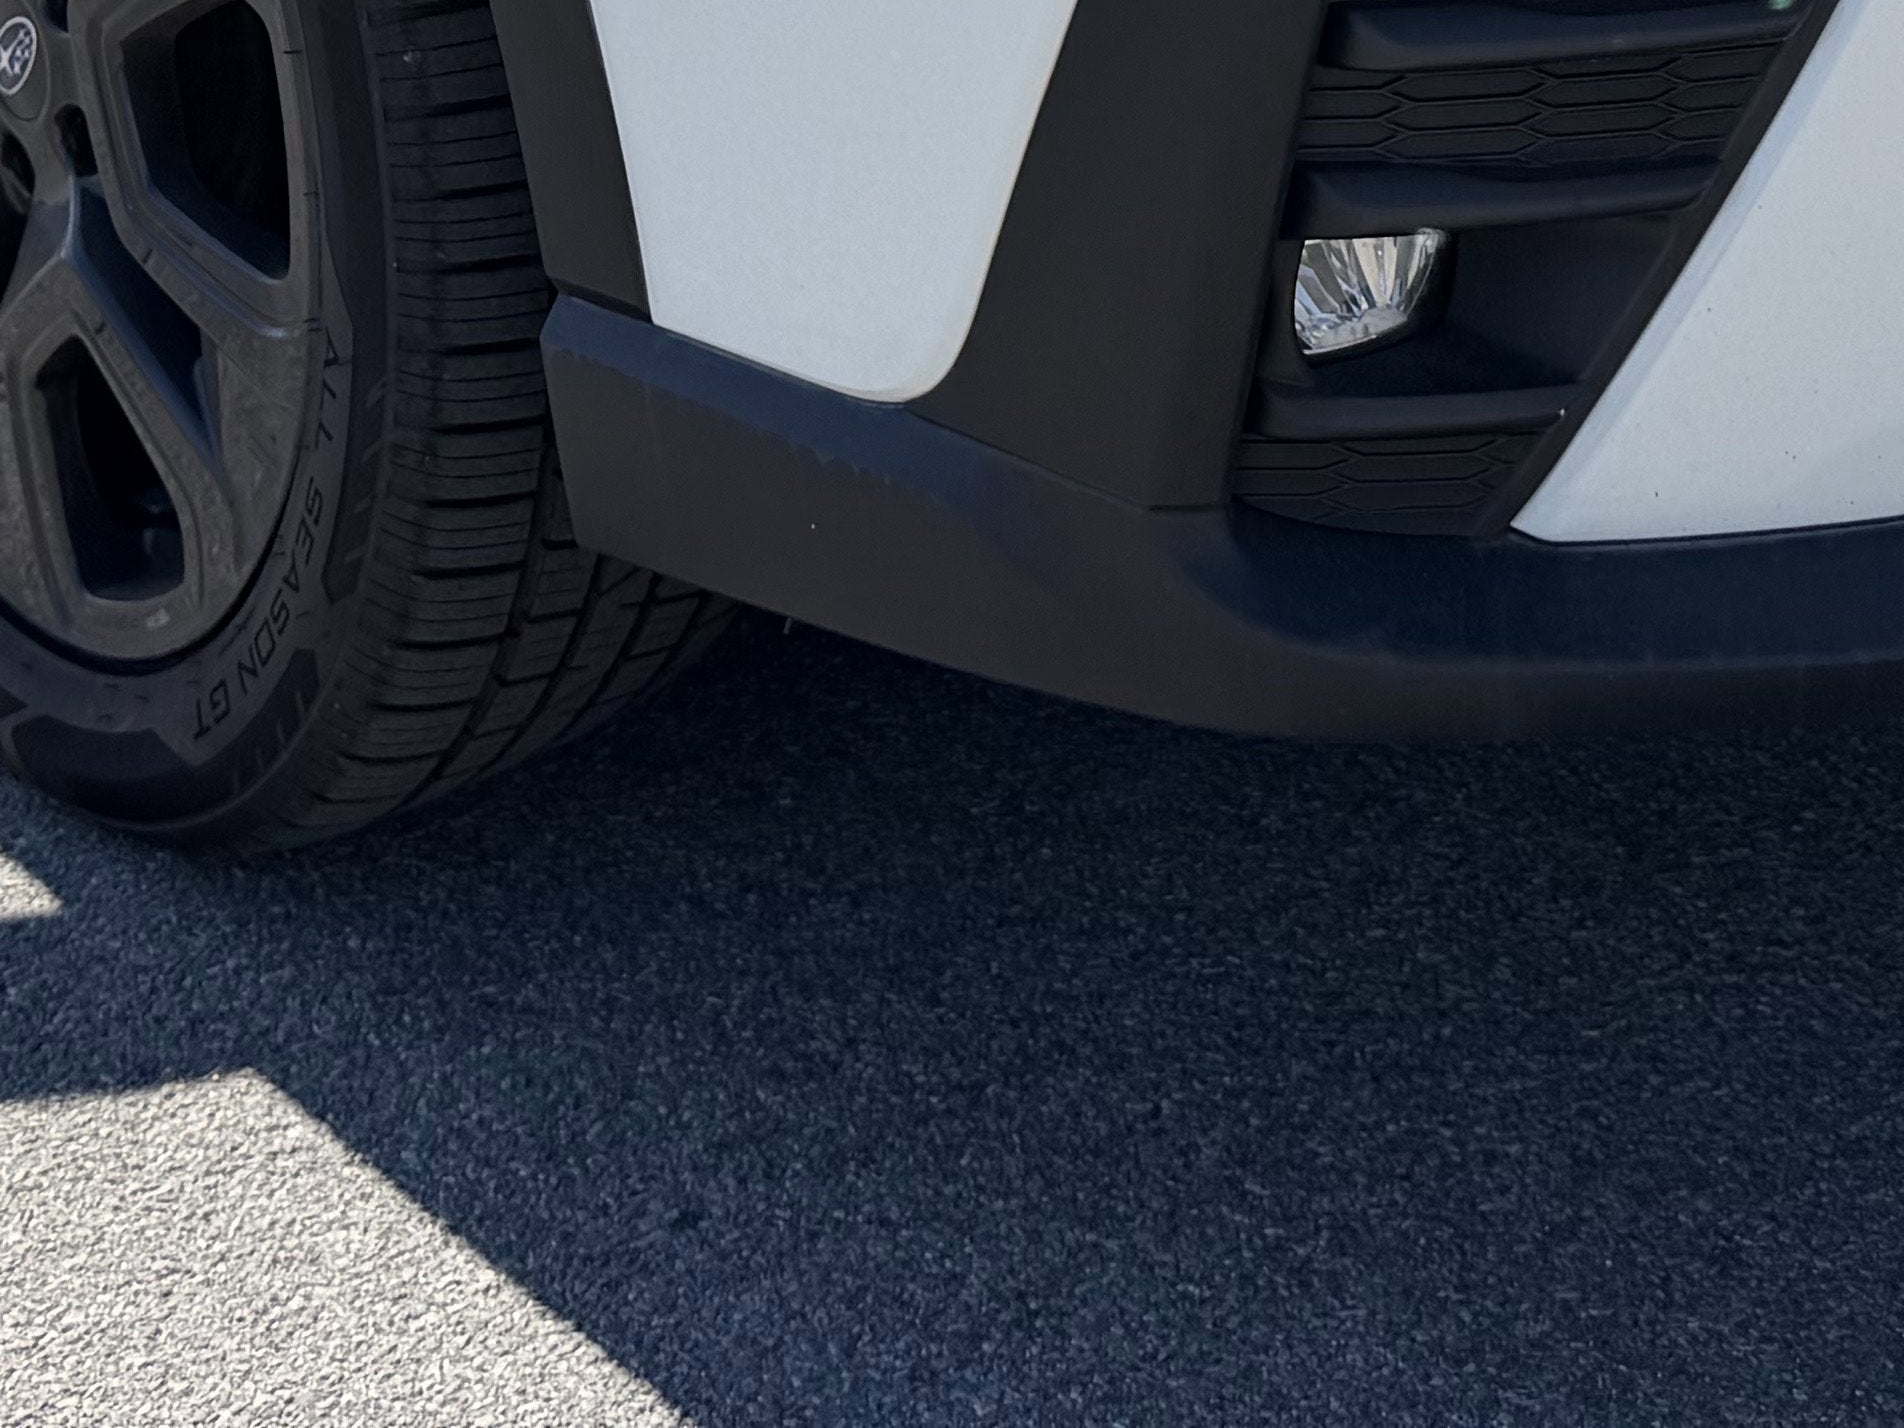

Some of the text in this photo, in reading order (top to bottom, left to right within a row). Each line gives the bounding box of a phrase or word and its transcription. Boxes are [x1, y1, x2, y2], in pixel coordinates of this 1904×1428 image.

[192, 325, 341, 741] ALL SEASON GT
